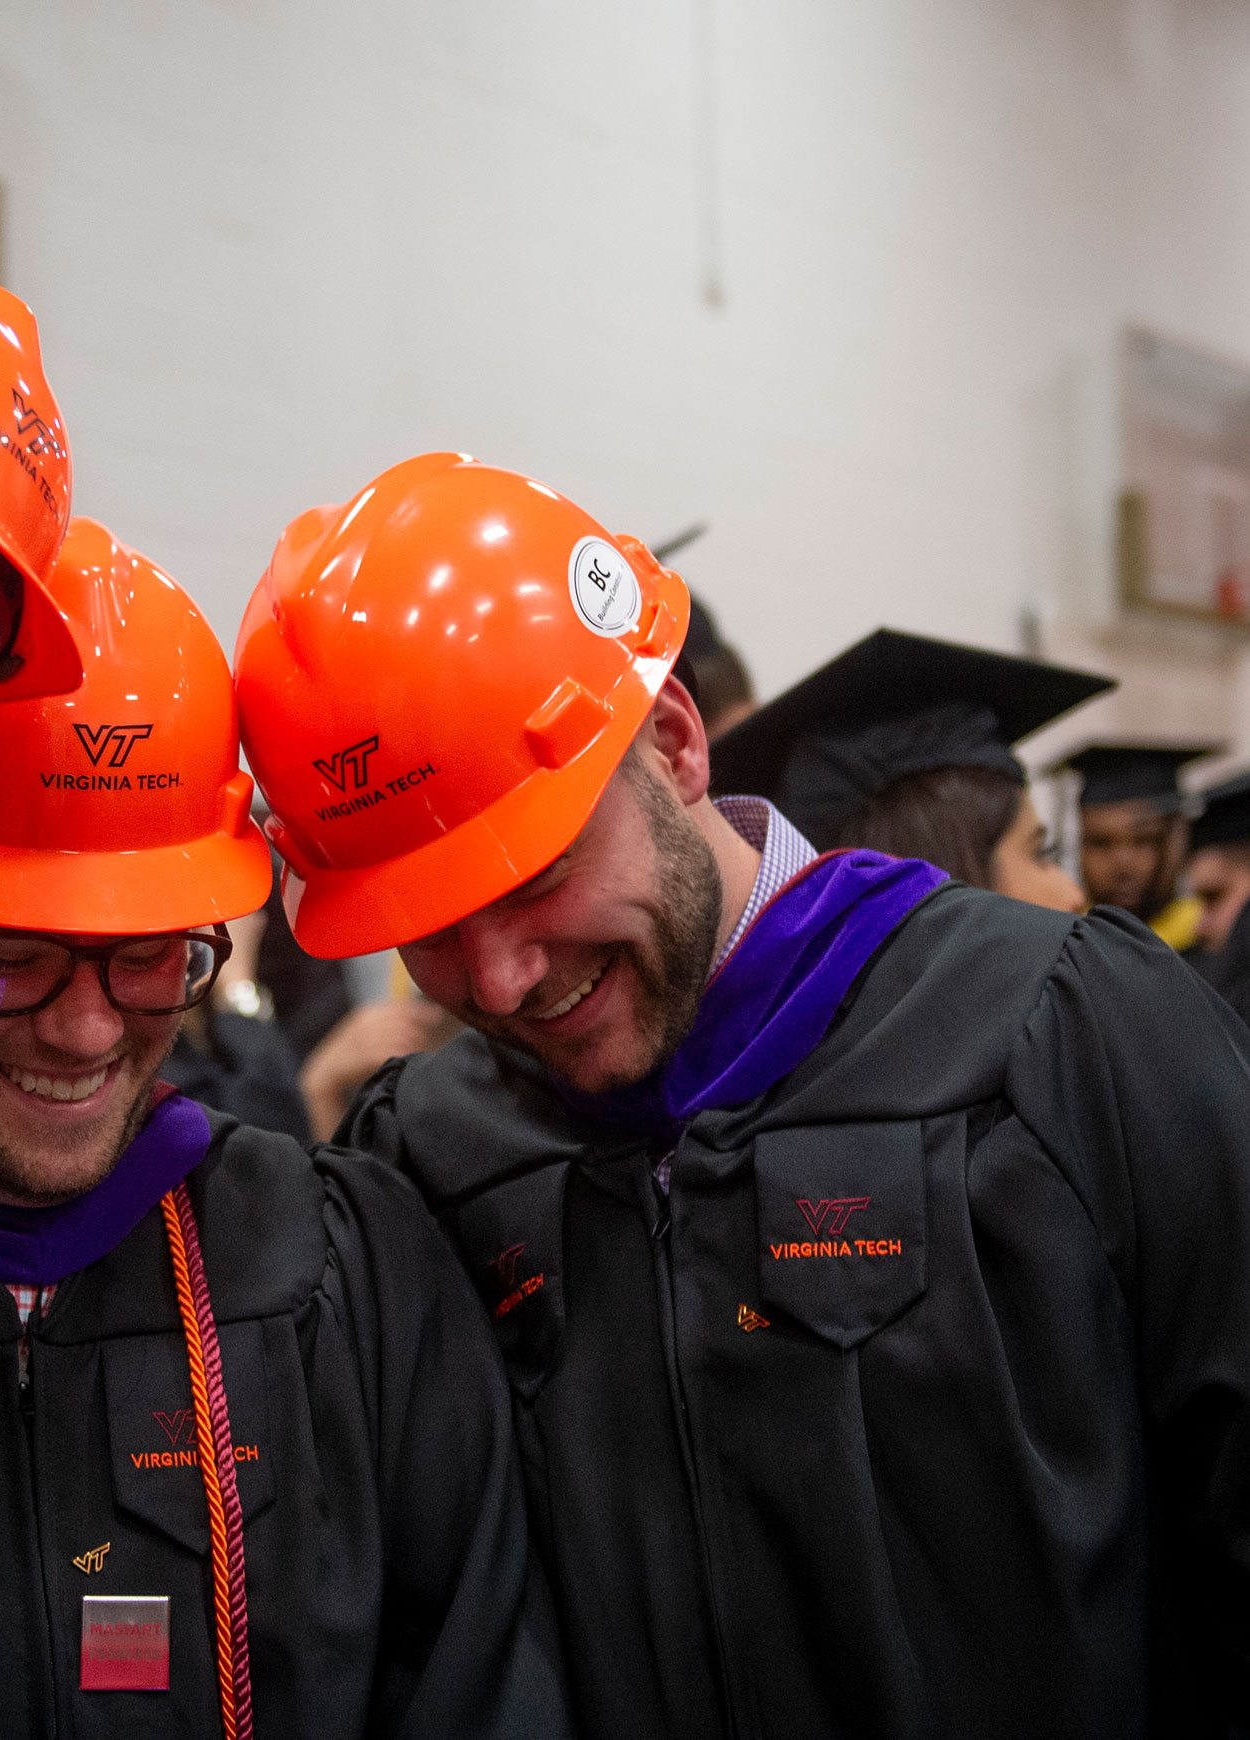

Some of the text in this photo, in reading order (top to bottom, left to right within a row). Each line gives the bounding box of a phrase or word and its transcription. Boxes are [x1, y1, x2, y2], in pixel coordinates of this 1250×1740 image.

[588, 558, 611, 592] BC
[72, 724, 154, 767] VT
[312, 734, 379, 792] VT
[39, 772, 180, 790] VIRGINIA TECH
[314, 762, 435, 822] VIRGINIA TECH
[796, 1197, 870, 1235] VT
[770, 1239, 902, 1259] VIRGINIA TECH
[521, 1272, 543, 1296] TECH
[131, 1445, 259, 1468] VIRGINI CH
[73, 1542, 110, 1575] VT
